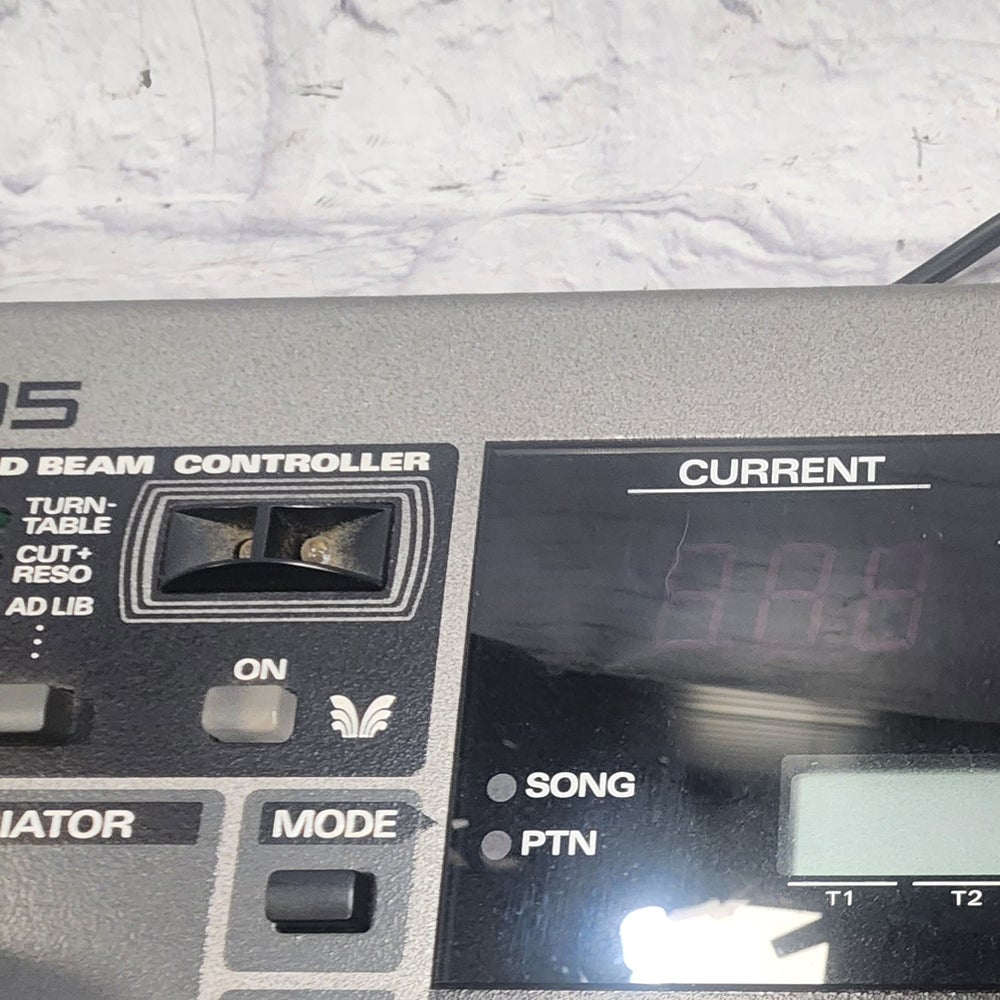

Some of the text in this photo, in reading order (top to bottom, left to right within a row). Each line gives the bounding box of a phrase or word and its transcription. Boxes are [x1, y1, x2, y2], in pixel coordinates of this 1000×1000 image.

[0, 381, 82, 429] 5
[0, 452, 430, 476] D BEAM CONTROLLER
[678, 456, 886, 487] CURRENT
[25, 496, 118, 515] TURN-
[22, 516, 112, 535] TABLE
[16, 545, 93, 563] CUT+
[12, 565, 92, 584] RESO
[5, 597, 94, 616] AD LIB
[233, 658, 288, 680] ON
[524, 772, 636, 799] SONG
[0, 809, 135, 839] IATOR
[271, 809, 397, 838] MODE
[520, 830, 598, 857] PTN
[825, 891, 854, 906] T1
[951, 890, 983, 906] T2
